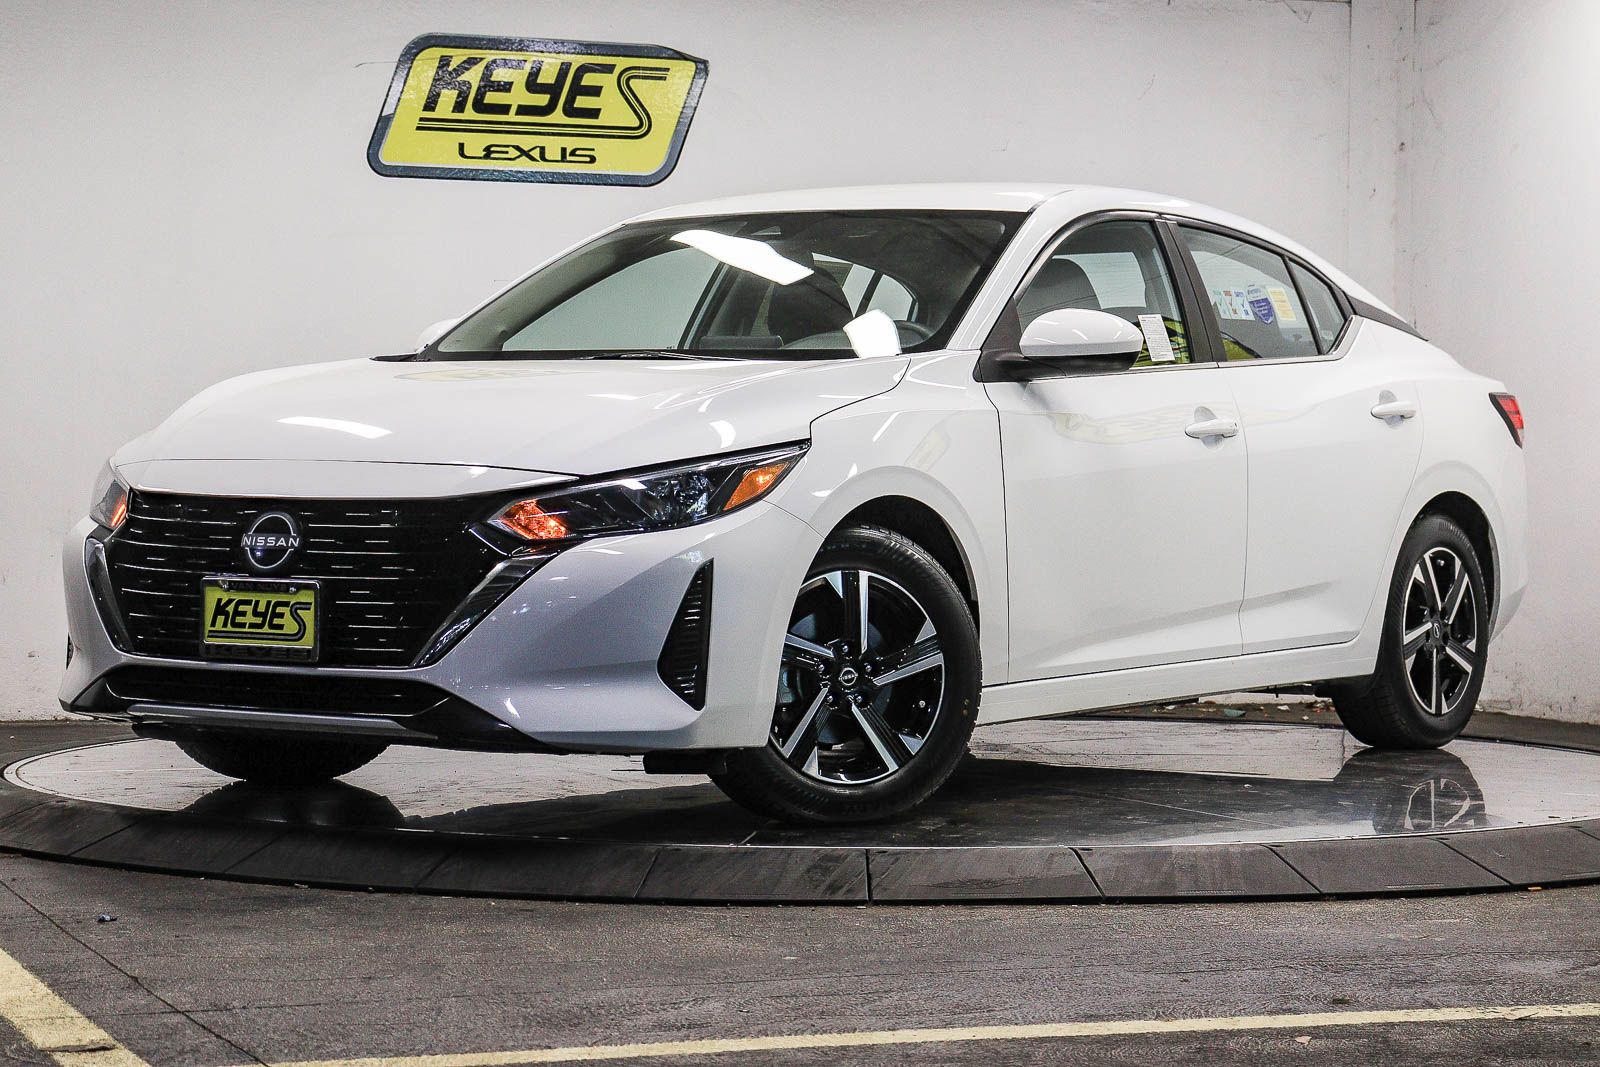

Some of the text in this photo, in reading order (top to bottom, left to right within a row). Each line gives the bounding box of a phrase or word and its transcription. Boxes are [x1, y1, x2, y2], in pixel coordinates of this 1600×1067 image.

[415, 54, 671, 140] KEYES
[457, 141, 598, 165] LEXUS
[241, 535, 300, 548] NISSAN
[206, 597, 313, 642] KEYES
